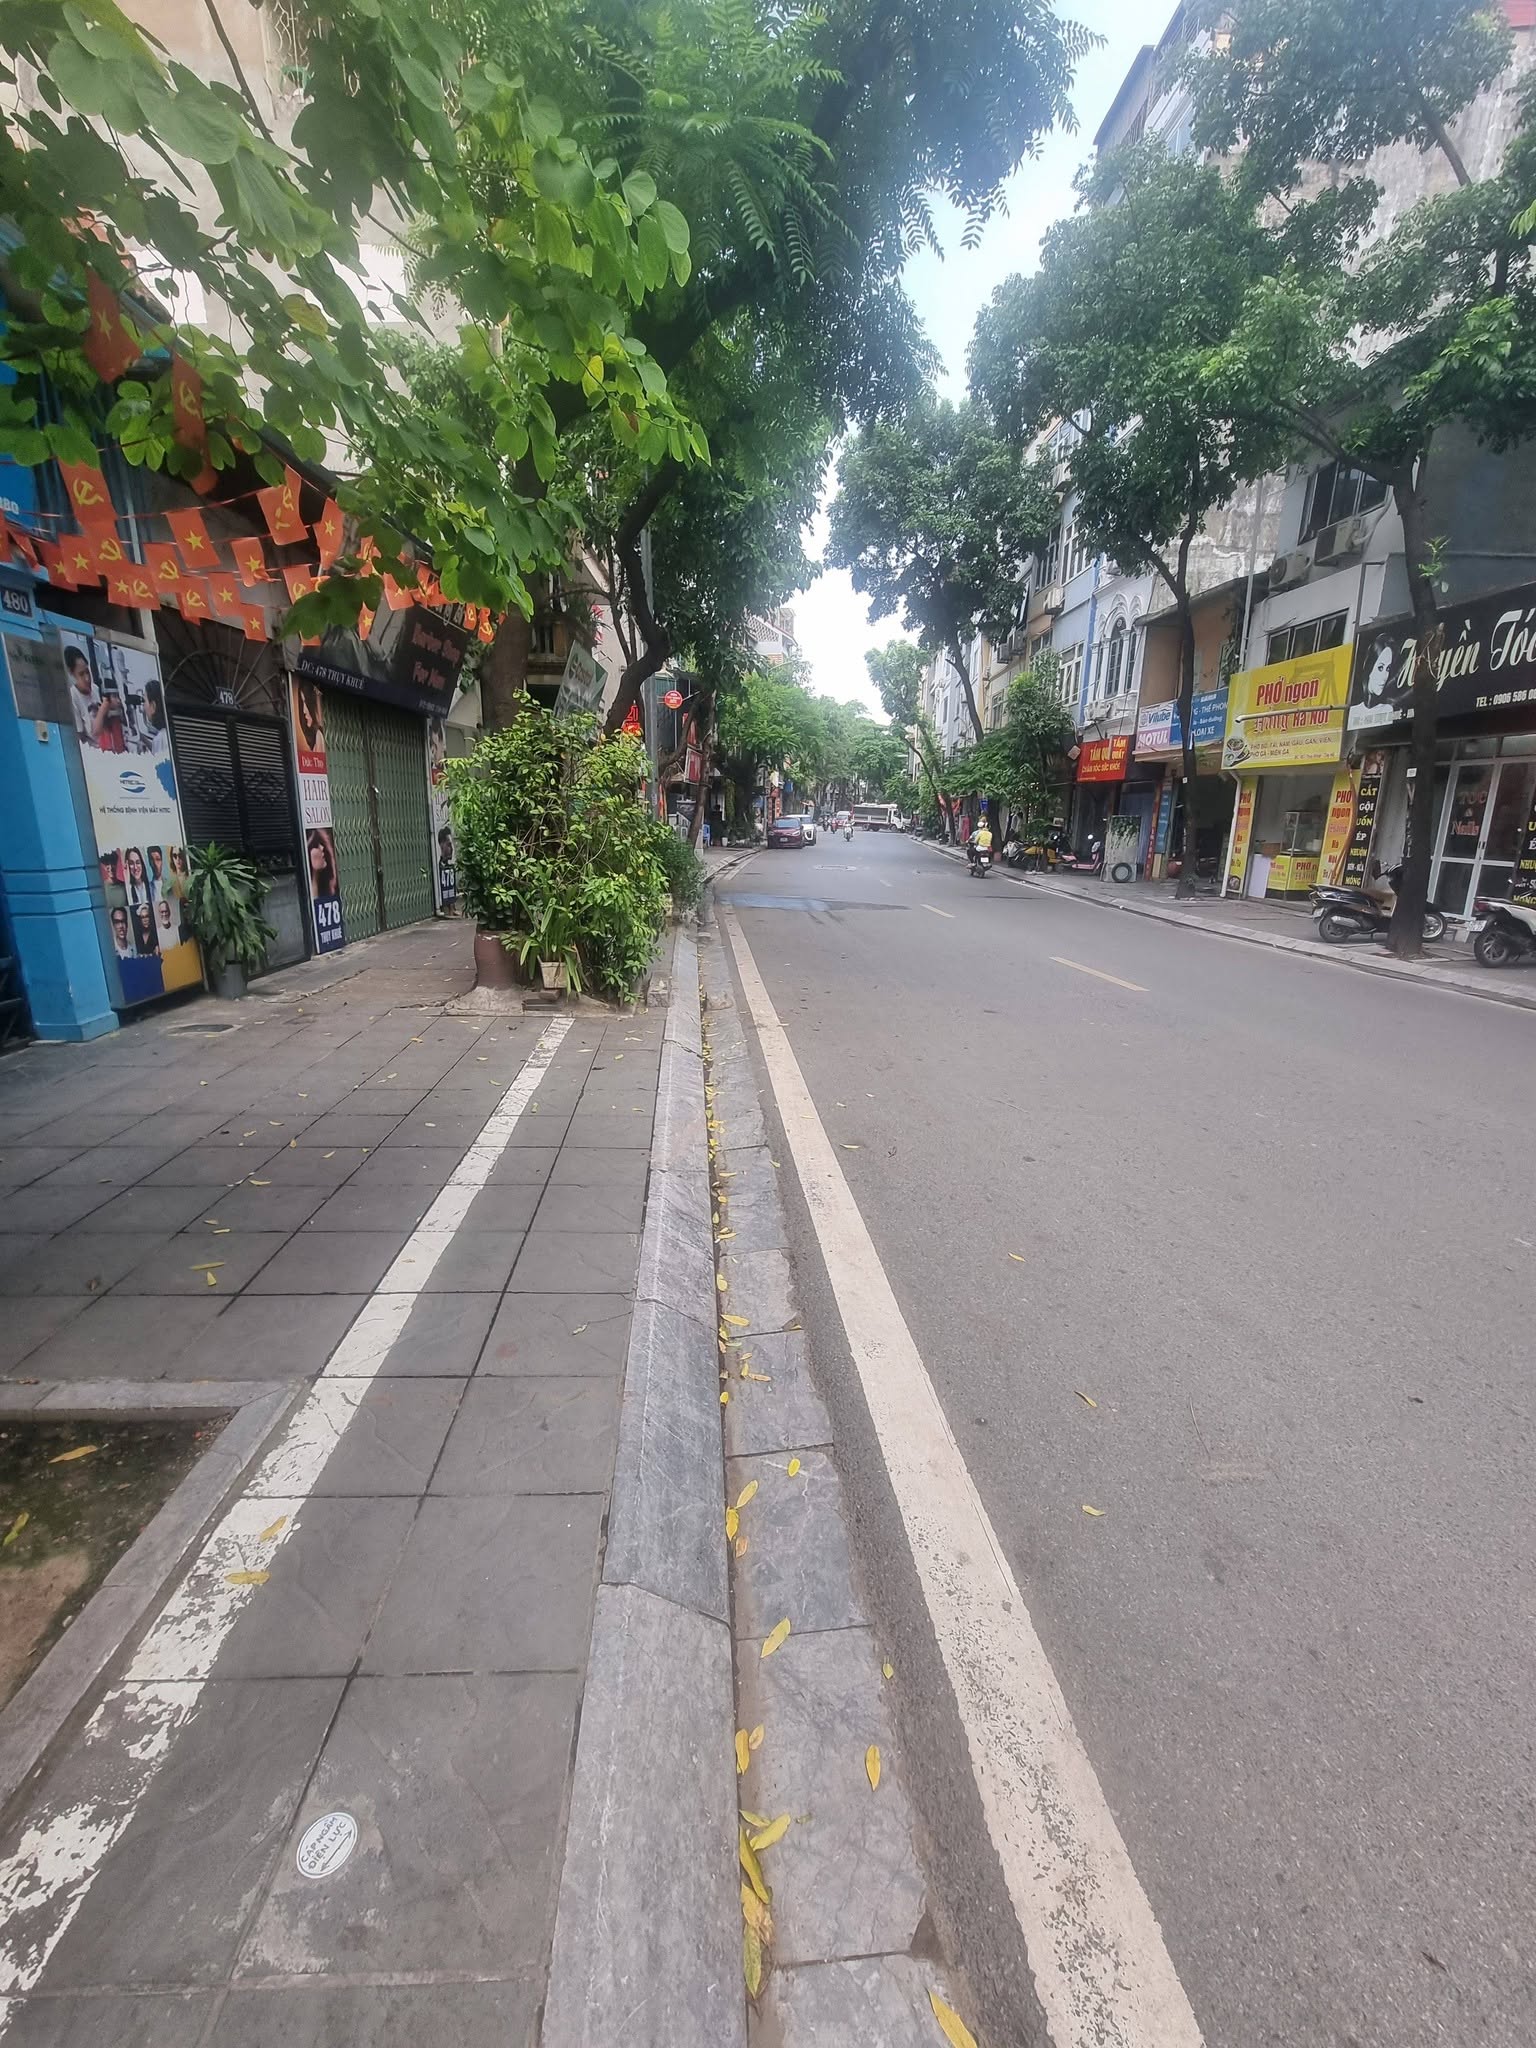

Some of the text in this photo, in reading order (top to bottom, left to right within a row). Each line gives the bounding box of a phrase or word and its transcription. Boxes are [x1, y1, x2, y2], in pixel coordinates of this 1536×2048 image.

[3, 589, 29, 613] 480
[219, 690, 234, 705] 478
[1256, 676, 1319, 707] PHỞ ngon
[1476, 696, 1488, 708] TEL
[1138, 730, 1168, 748] MOTUL
[1207, 725, 1215, 735] XE
[303, 779, 329, 801] HAIR
[304, 806, 331, 824] SALON
[1359, 802, 1374, 815] GỘI
[1355, 831, 1367, 841] ÉP
[441, 869, 455, 888] 478
[318, 899, 341, 928] 478
